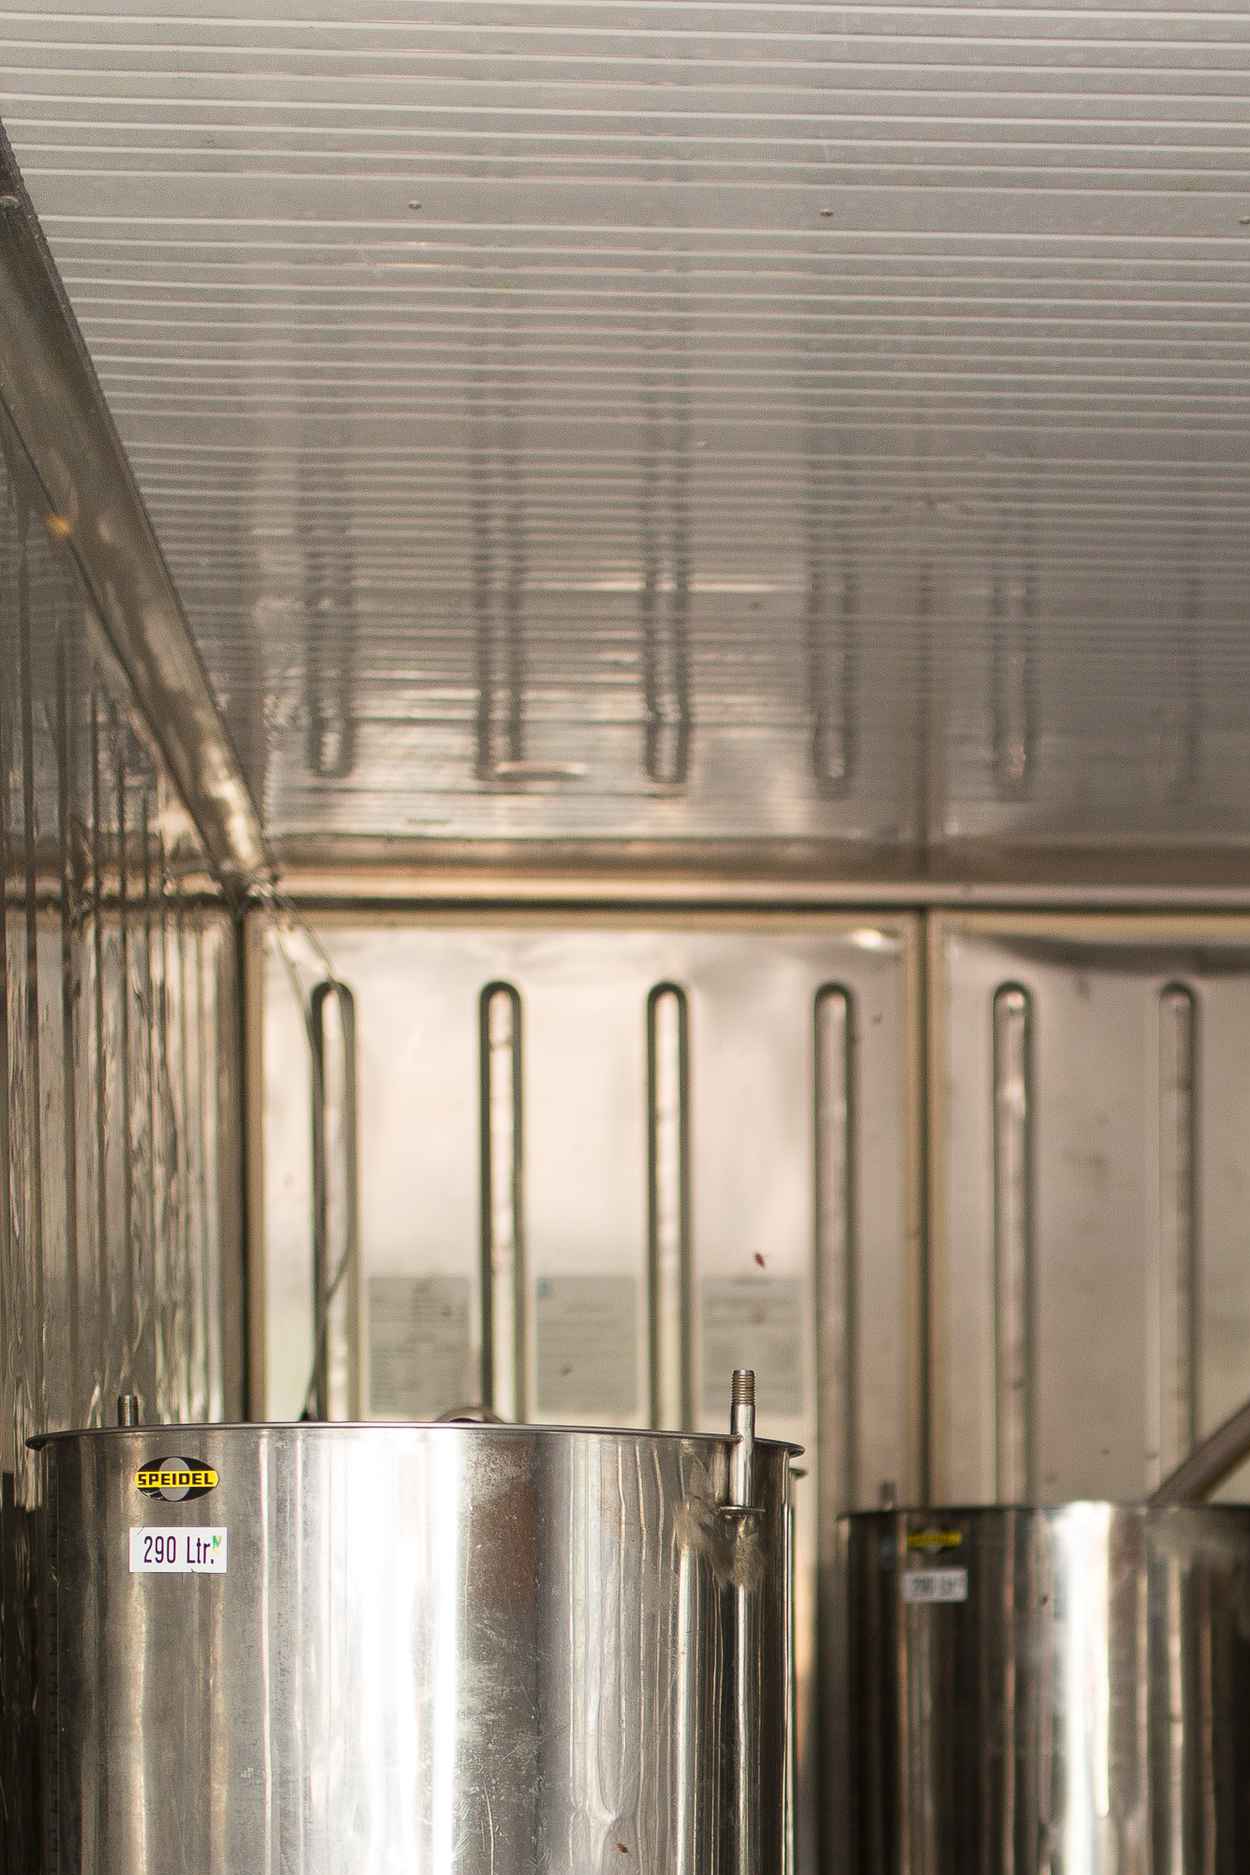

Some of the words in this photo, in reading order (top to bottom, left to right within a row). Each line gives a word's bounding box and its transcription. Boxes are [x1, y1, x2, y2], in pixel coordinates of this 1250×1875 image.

[138, 1473, 214, 1486] SPEIDEL
[144, 1536, 176, 1564] 290
[187, 1536, 214, 1564] Ltr.
